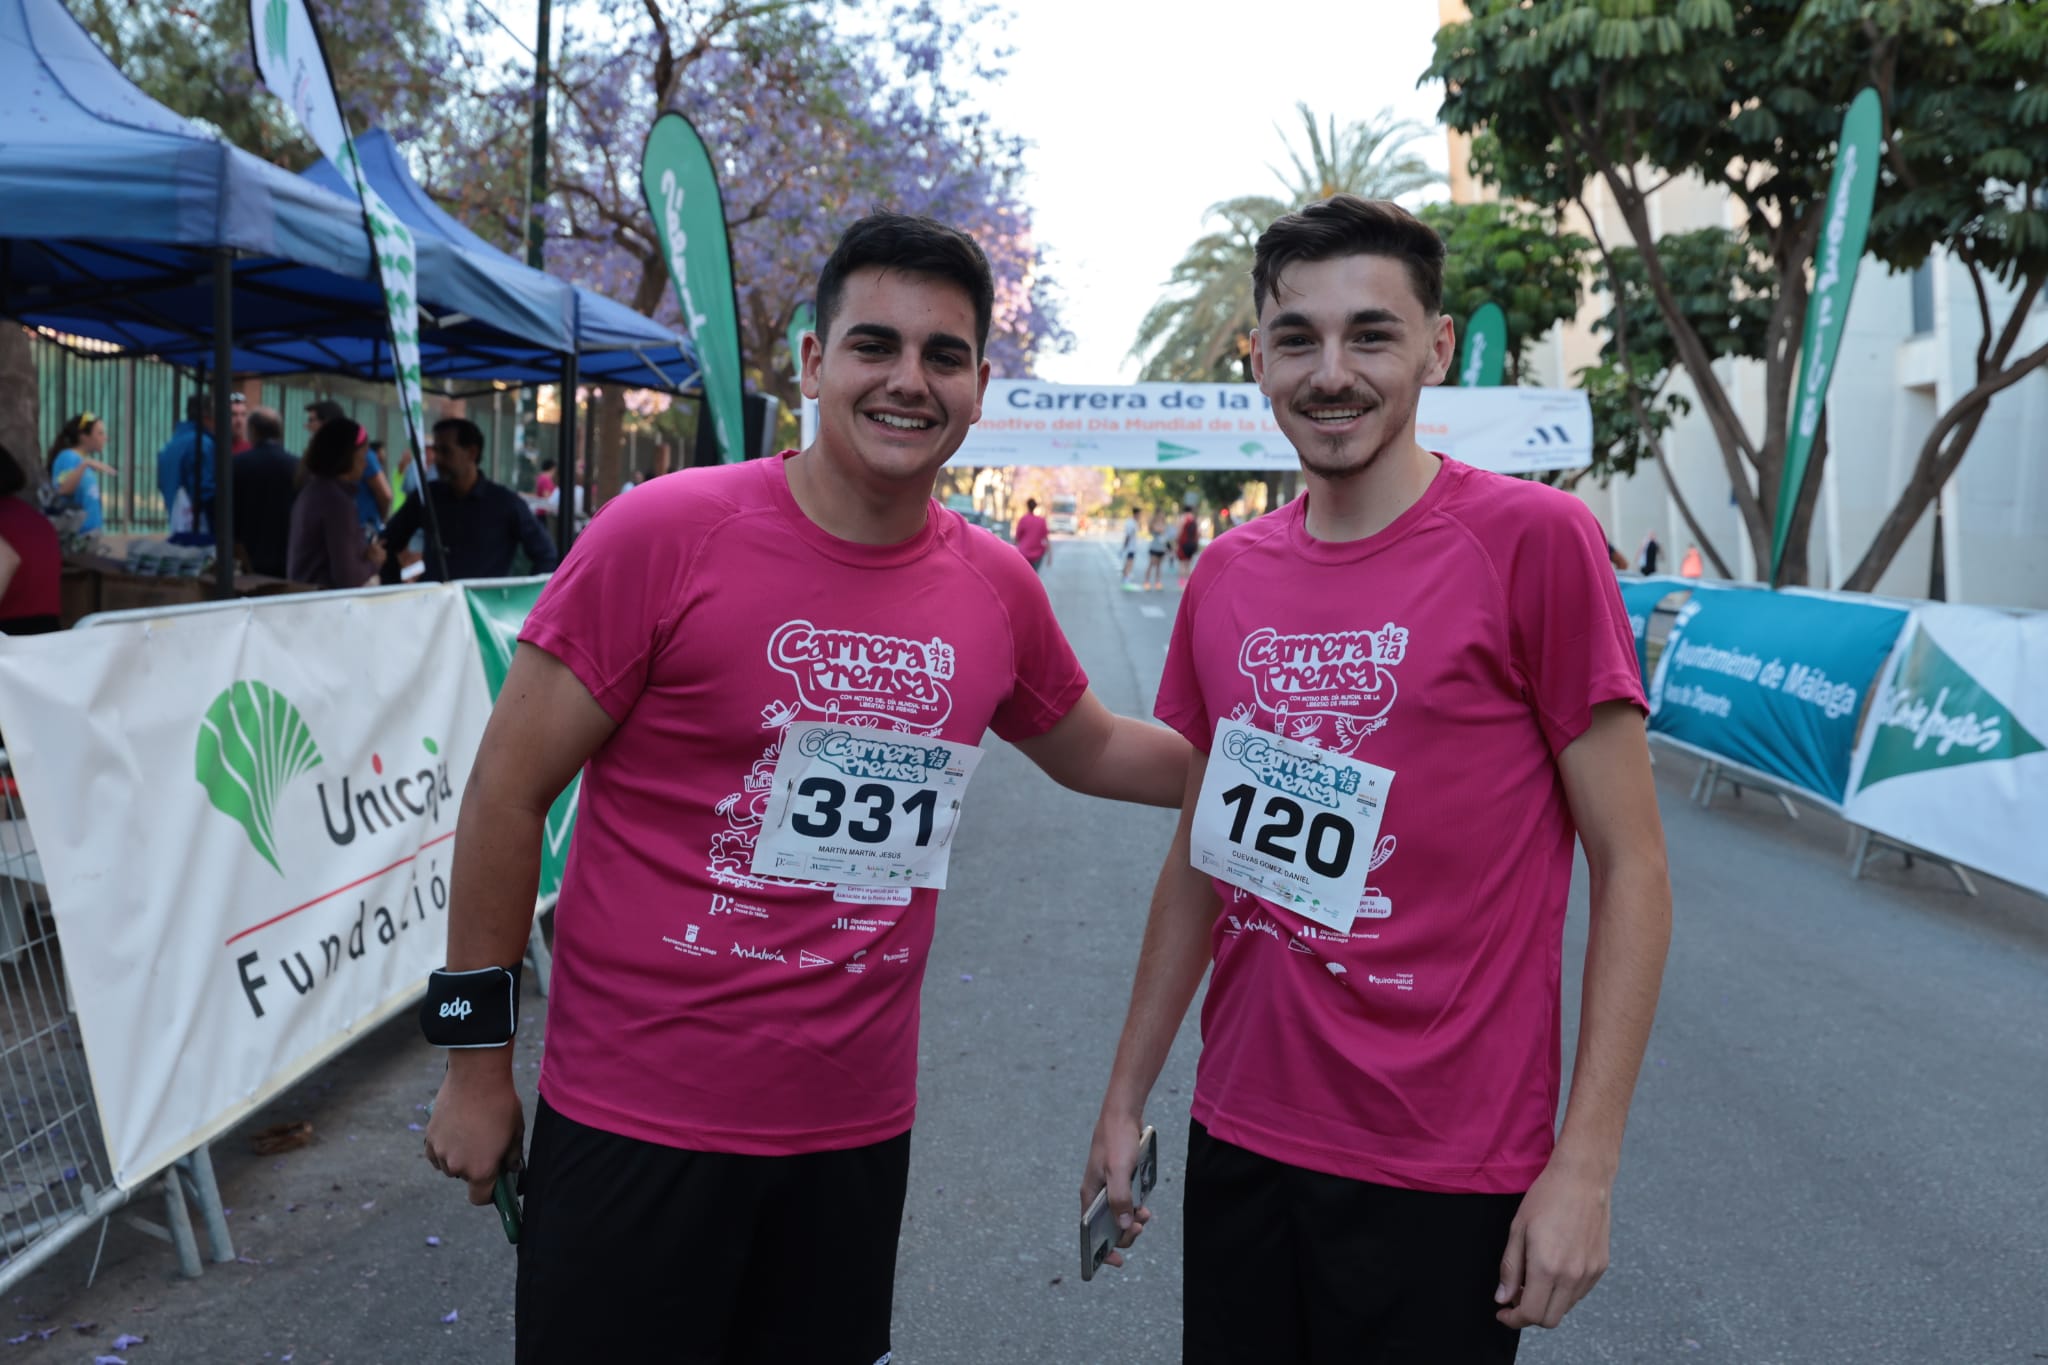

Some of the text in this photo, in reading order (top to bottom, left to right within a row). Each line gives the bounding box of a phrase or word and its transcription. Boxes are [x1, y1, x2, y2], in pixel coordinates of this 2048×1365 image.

[1007, 388, 1147, 410] Carrera
[1160, 389, 1206, 410] de
[1218, 389, 1250, 410] la
[977, 417, 1046, 431] motivo
[1052, 417, 1083, 431] del
[1125, 418, 1203, 432] Mundial
[1208, 418, 1233, 432] de
[1239, 418, 1256, 432] la
[779, 631, 951, 669] Carrera de
[1247, 629, 1404, 664] Carrera de
[809, 657, 951, 700] Prensa la
[1264, 644, 1401, 692] Prensa la
[1674, 637, 1762, 682] Ayuntamiento
[1757, 657, 1786, 690] de
[1782, 661, 1858, 720] Málaga
[824, 735, 927, 764] Carrera
[928, 746, 950, 759] de
[1244, 742, 1336, 786] Carrera
[1339, 767, 1359, 782] de
[842, 756, 928, 783] Prensa
[1258, 766, 1339, 808] Prensa
[791, 776, 939, 847] 331
[1221, 783, 1356, 879] 120
[817, 845, 848, 856] MARTÍN
[878, 850, 902, 860] JESÚS
[1232, 850, 1259, 865] CUEVAS
[1284, 870, 1311, 885] DANIEL
[236, 859, 448, 1018] Fundaió
[730, 941, 788, 965] Andalucía
[439, 996, 473, 1020] edp
